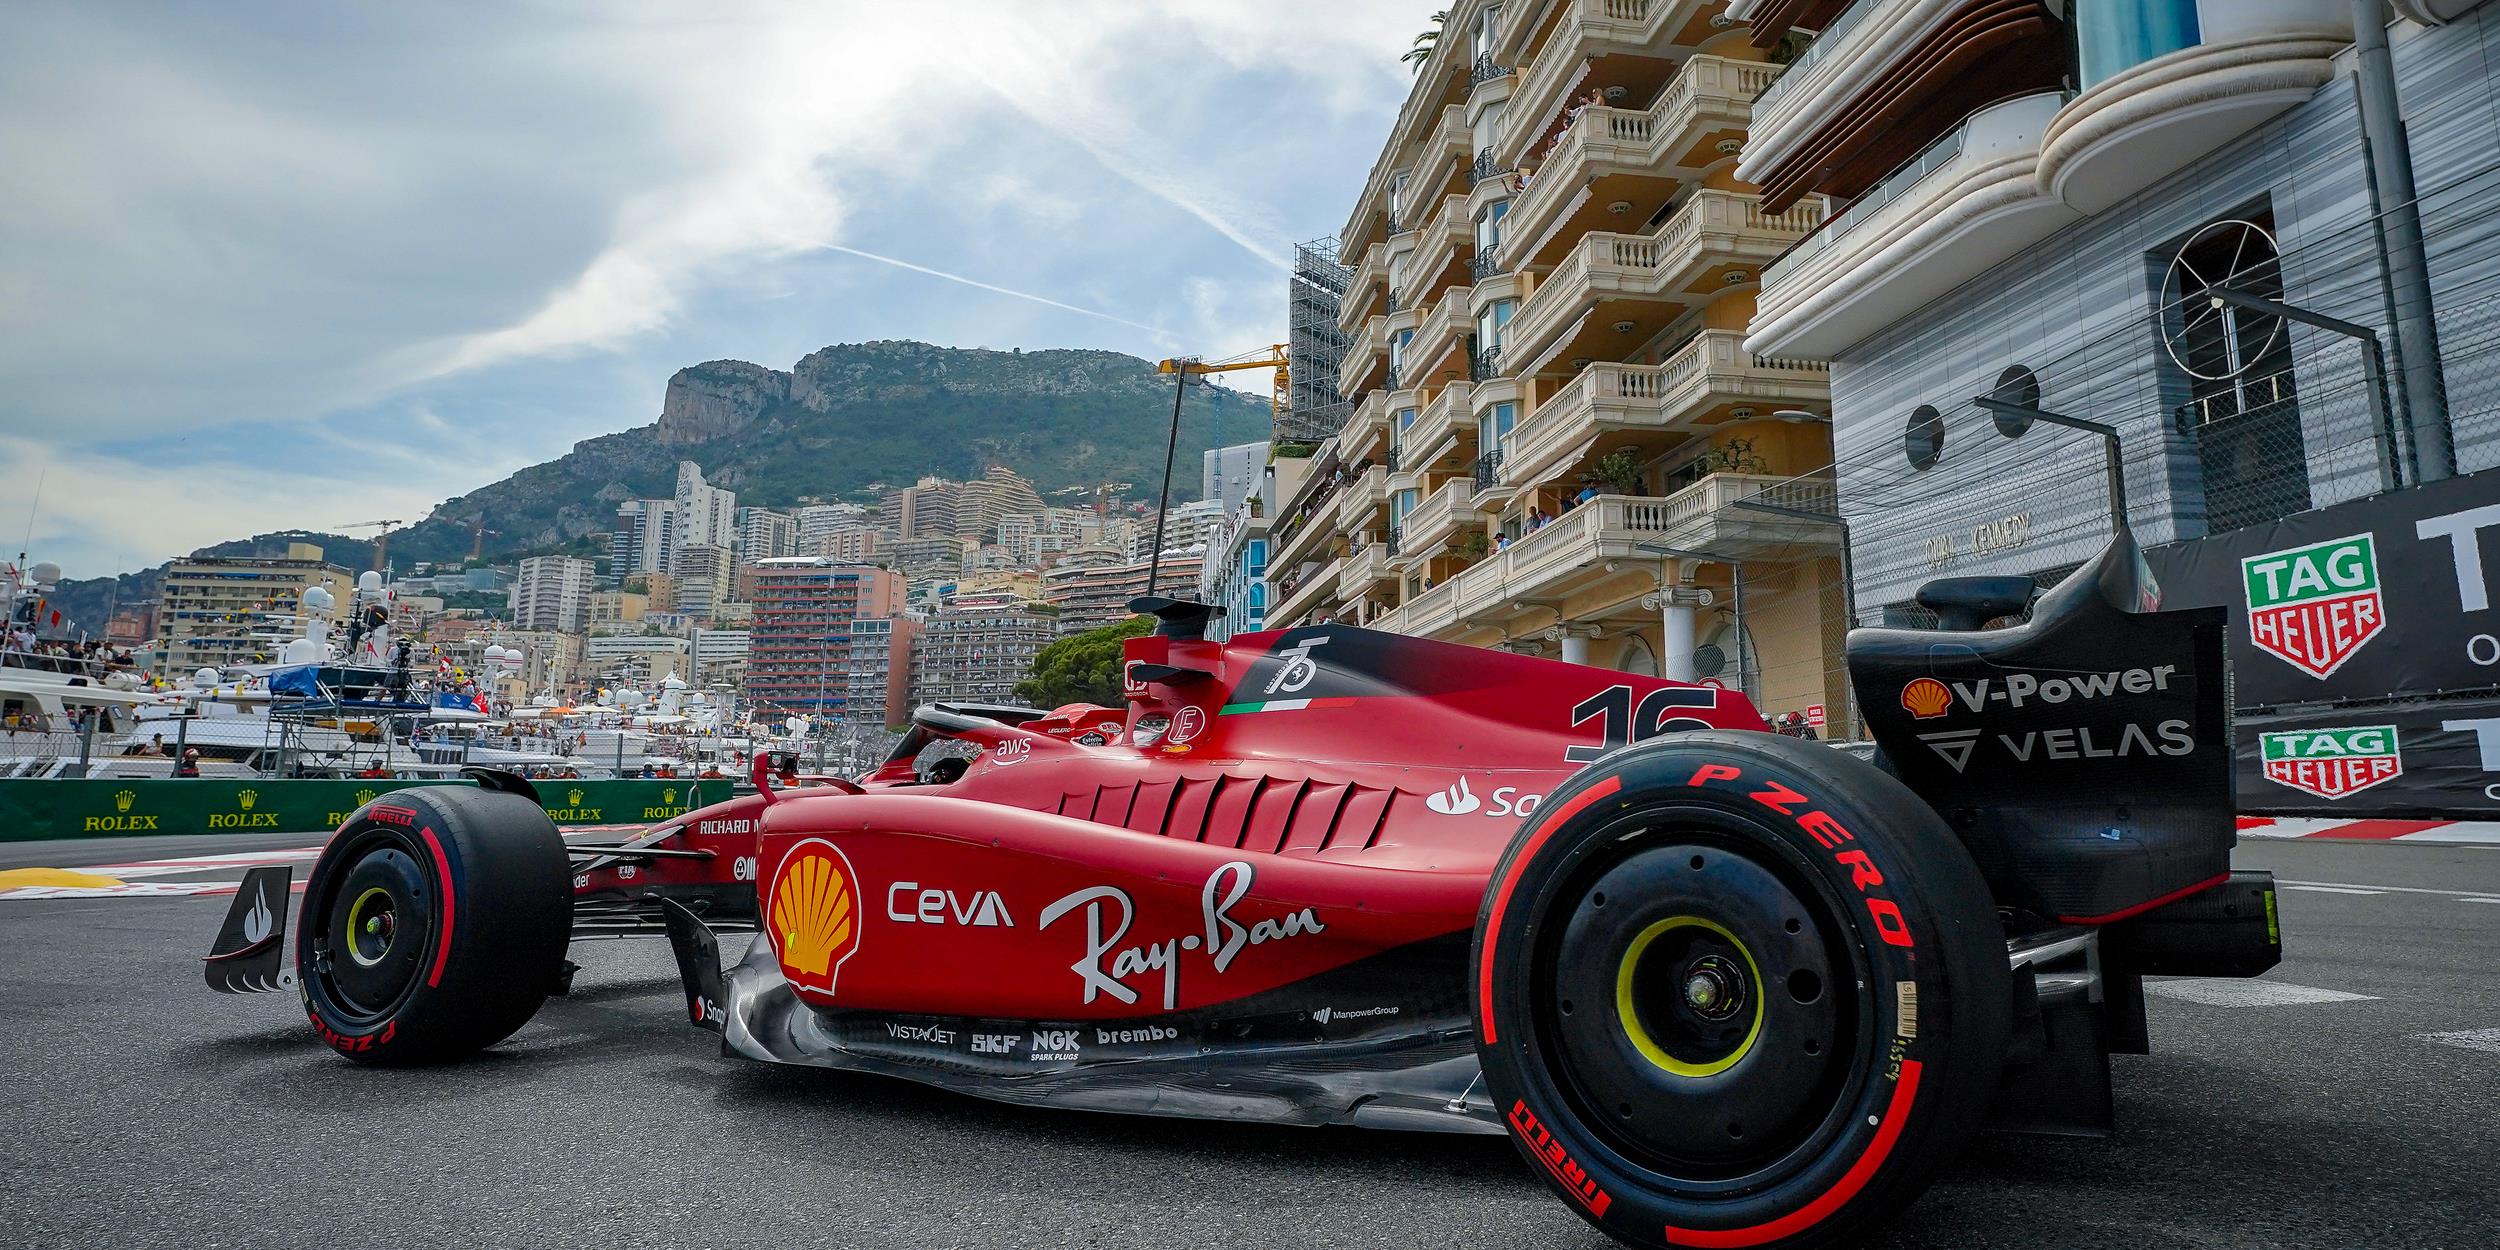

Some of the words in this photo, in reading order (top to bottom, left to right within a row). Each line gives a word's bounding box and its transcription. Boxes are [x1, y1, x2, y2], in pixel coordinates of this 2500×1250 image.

[2253, 546, 2366, 601] TAG
[2257, 597, 2377, 670] HEUER
[1952, 664, 2176, 713] V-Power
[1564, 684, 1717, 763] 16
[996, 737, 1032, 756] aws
[1998, 719, 2196, 762] VELAS
[2272, 730, 2386, 757] TAG
[2271, 758, 2395, 795] HEUER
[84, 814, 159, 832] ROLEX
[208, 812, 280, 828] ROLEX
[367, 804, 418, 827] PIRELLI
[547, 809, 601, 821] ROLEX
[700, 819, 750, 834] RICHARD
[1687, 763, 1742, 788] P
[1749, 780, 1915, 948] ZERO
[1333, 1006, 1400, 1019] ManpowerGroup
[971, 1033, 1021, 1053] SKF
[1031, 1030, 1081, 1052] NGK
[1096, 1026, 1178, 1045] brembo
[1031, 1052, 1053, 1061] SPARK
[1054, 1052, 1079, 1061] PLUGS
[1508, 1098, 1612, 1219] PIRELLI
